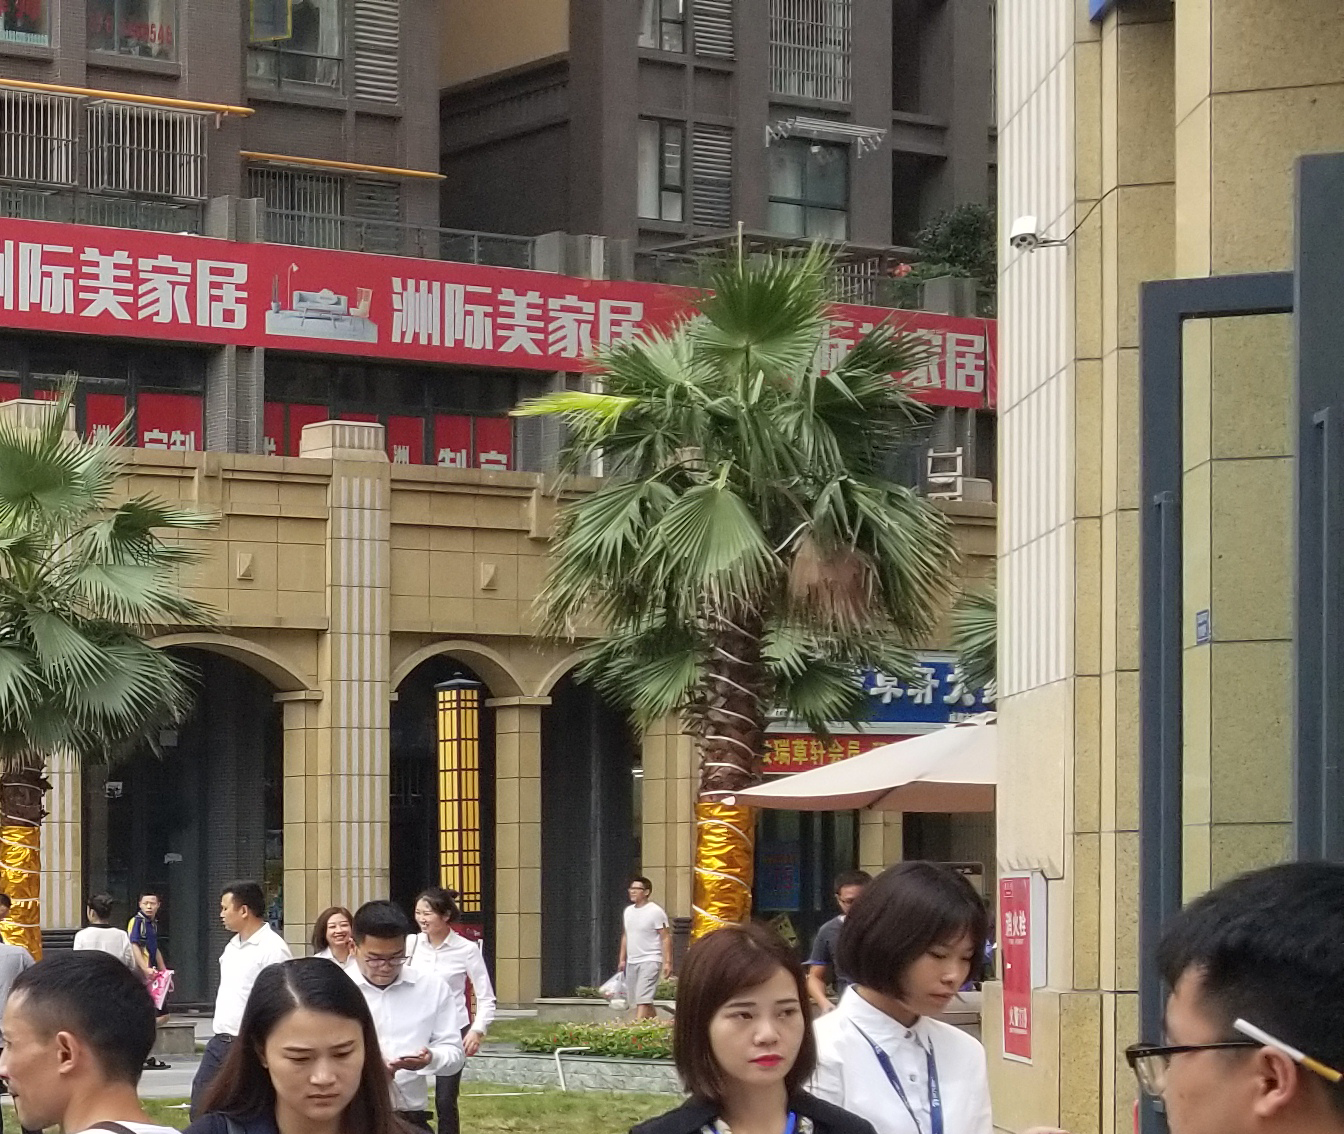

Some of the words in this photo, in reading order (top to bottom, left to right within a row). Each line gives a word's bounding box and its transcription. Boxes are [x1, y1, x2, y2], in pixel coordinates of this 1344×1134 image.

[391, 276, 645, 359] 洲际美家居
